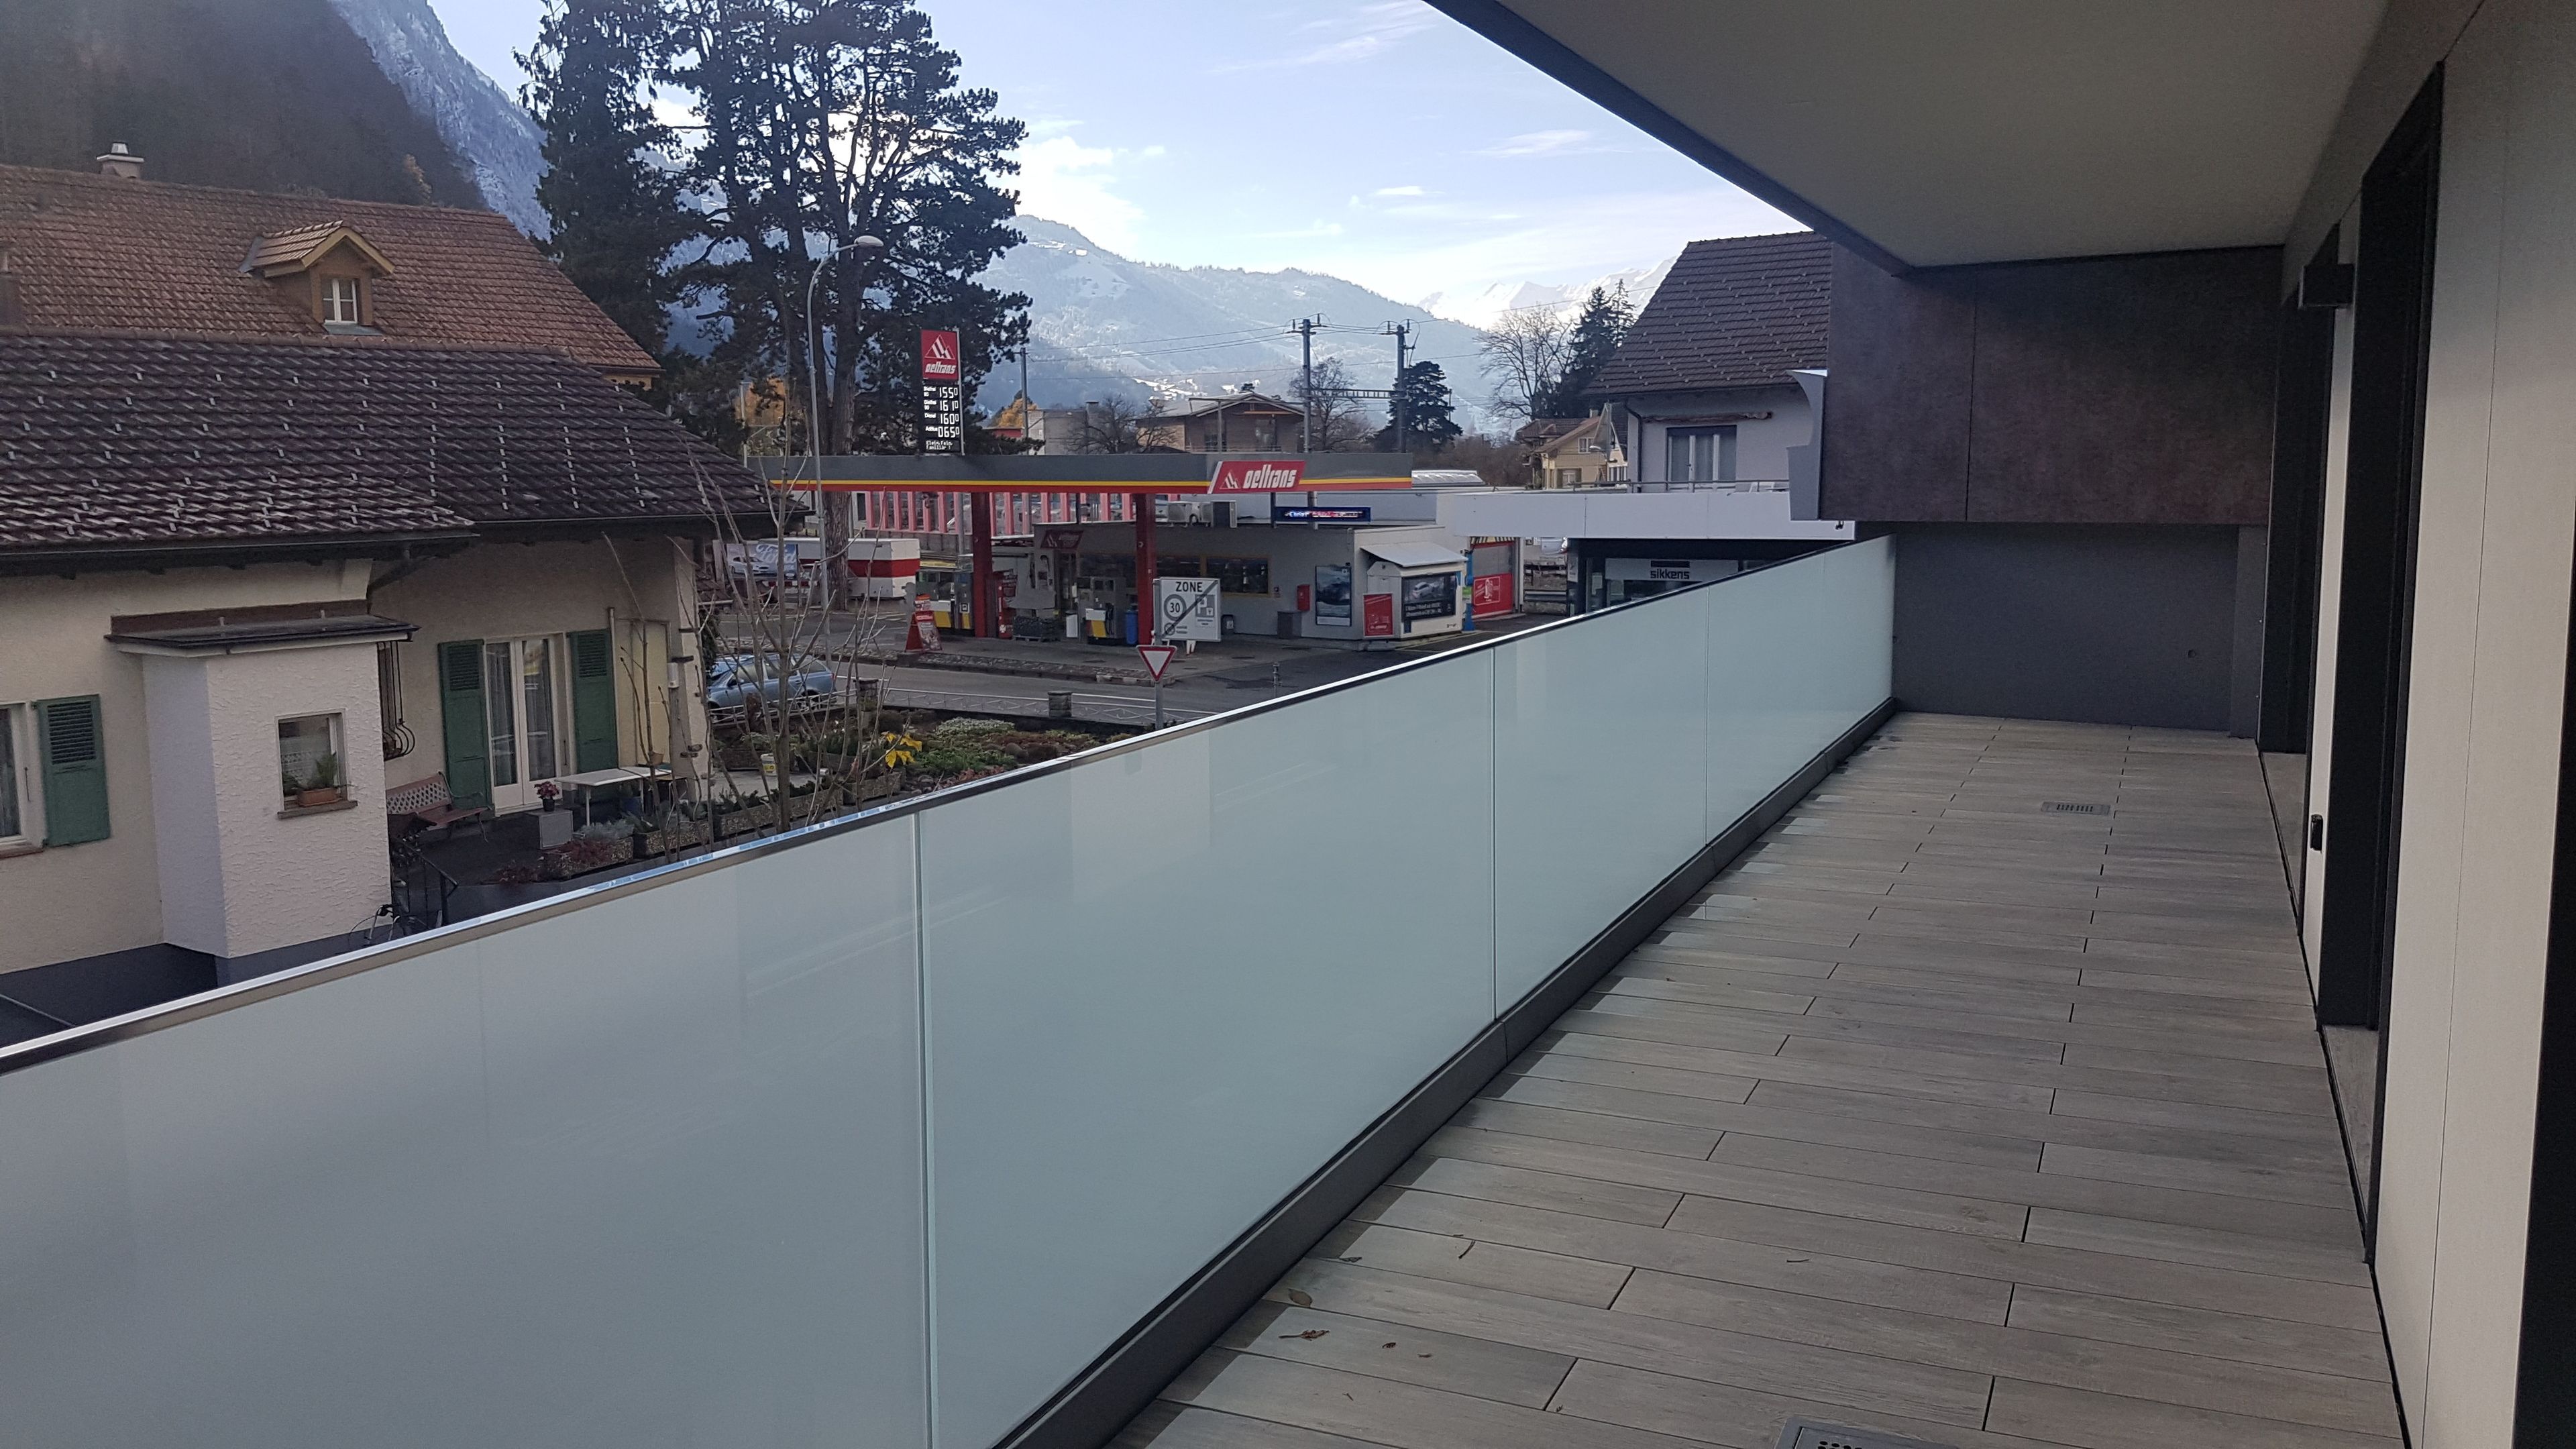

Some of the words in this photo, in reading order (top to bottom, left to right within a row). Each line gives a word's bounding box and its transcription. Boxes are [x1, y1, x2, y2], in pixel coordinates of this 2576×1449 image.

[925, 361, 957, 374] oeltrans
[1242, 464, 1297, 489] oeltrans
[1650, 568, 1690, 580] sikkens
[1175, 581, 1203, 592] ZONE
[1169, 602, 1181, 613] 30
